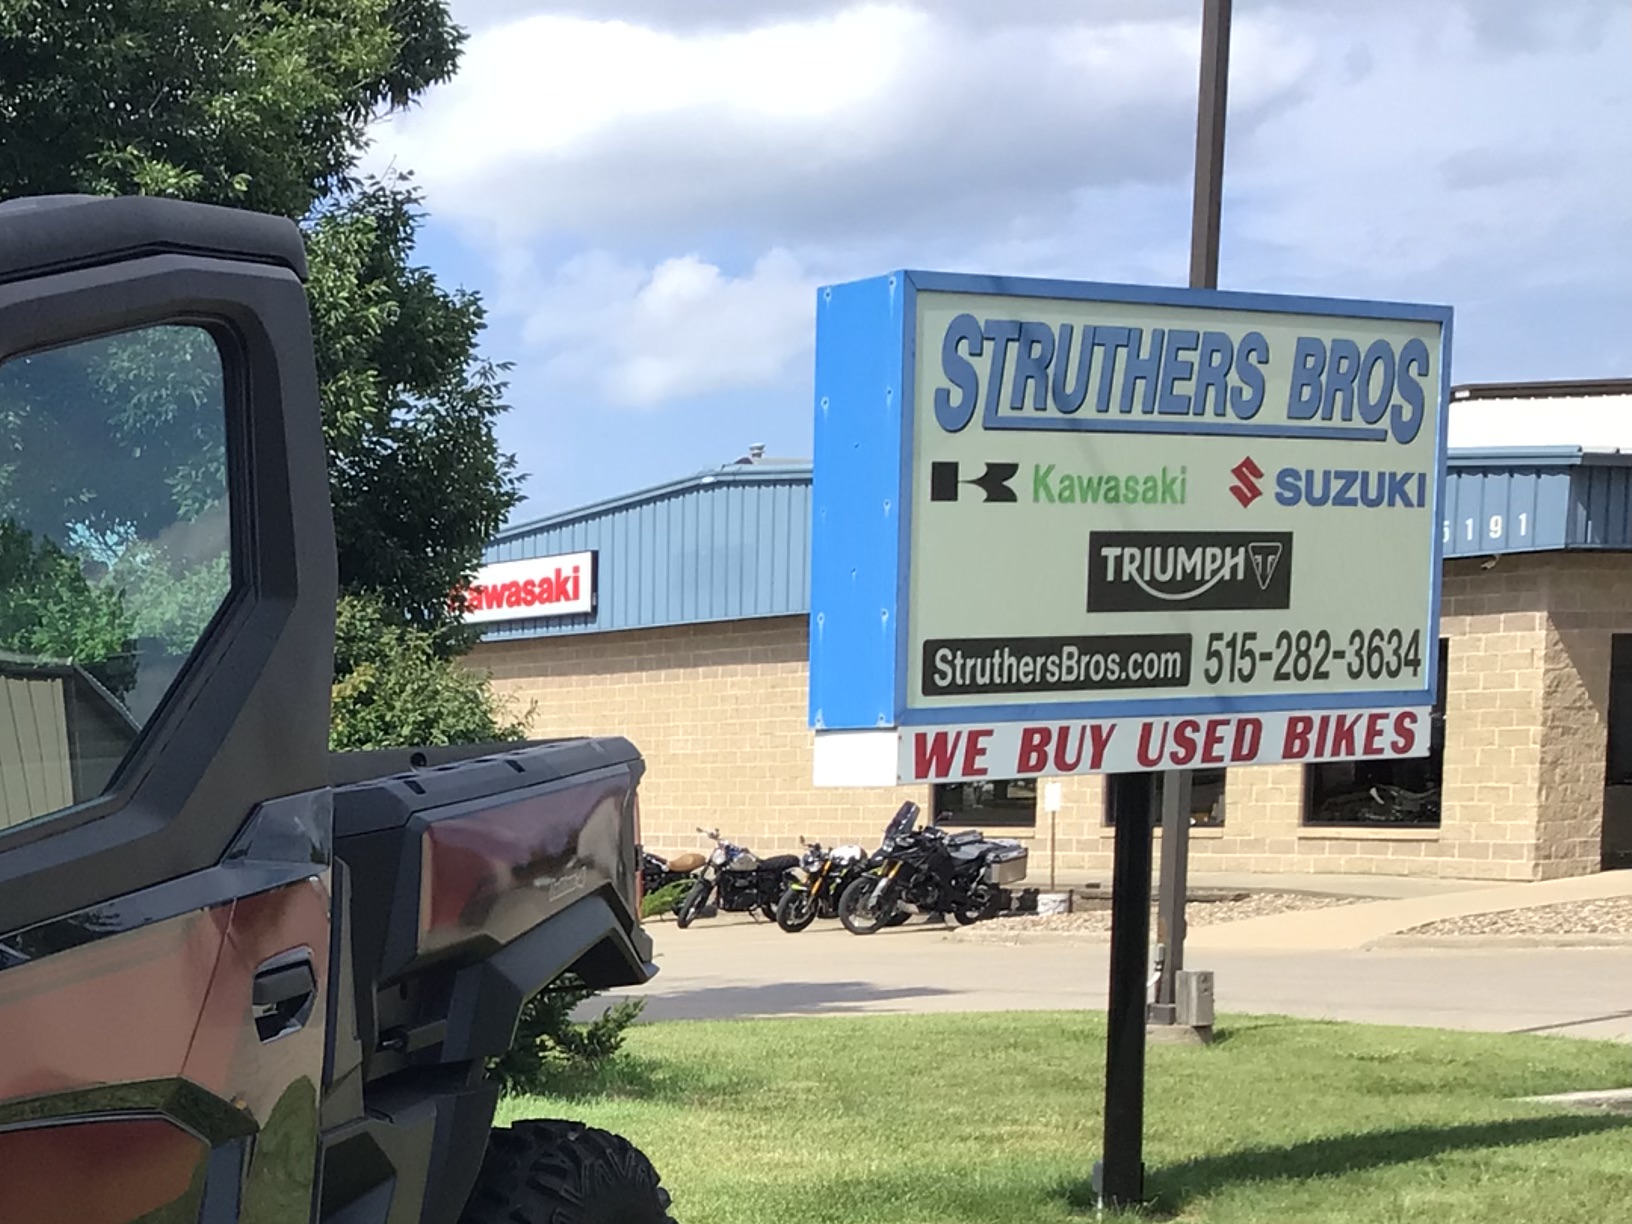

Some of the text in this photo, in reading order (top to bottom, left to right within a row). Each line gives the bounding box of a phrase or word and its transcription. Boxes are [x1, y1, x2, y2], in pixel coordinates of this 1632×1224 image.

[934, 313, 1430, 445] STRUTHERS BROS
[1032, 463, 1187, 505] Kawasaki
[1274, 467, 1427, 508] SUZUKI
[1100, 546, 1246, 600] TRIUMPH
[933, 645, 1182, 687] StruthersBros.com
[1203, 628, 1422, 684] 515-282-3634
[914, 711, 1418, 779] WE BUY USED BIKES
